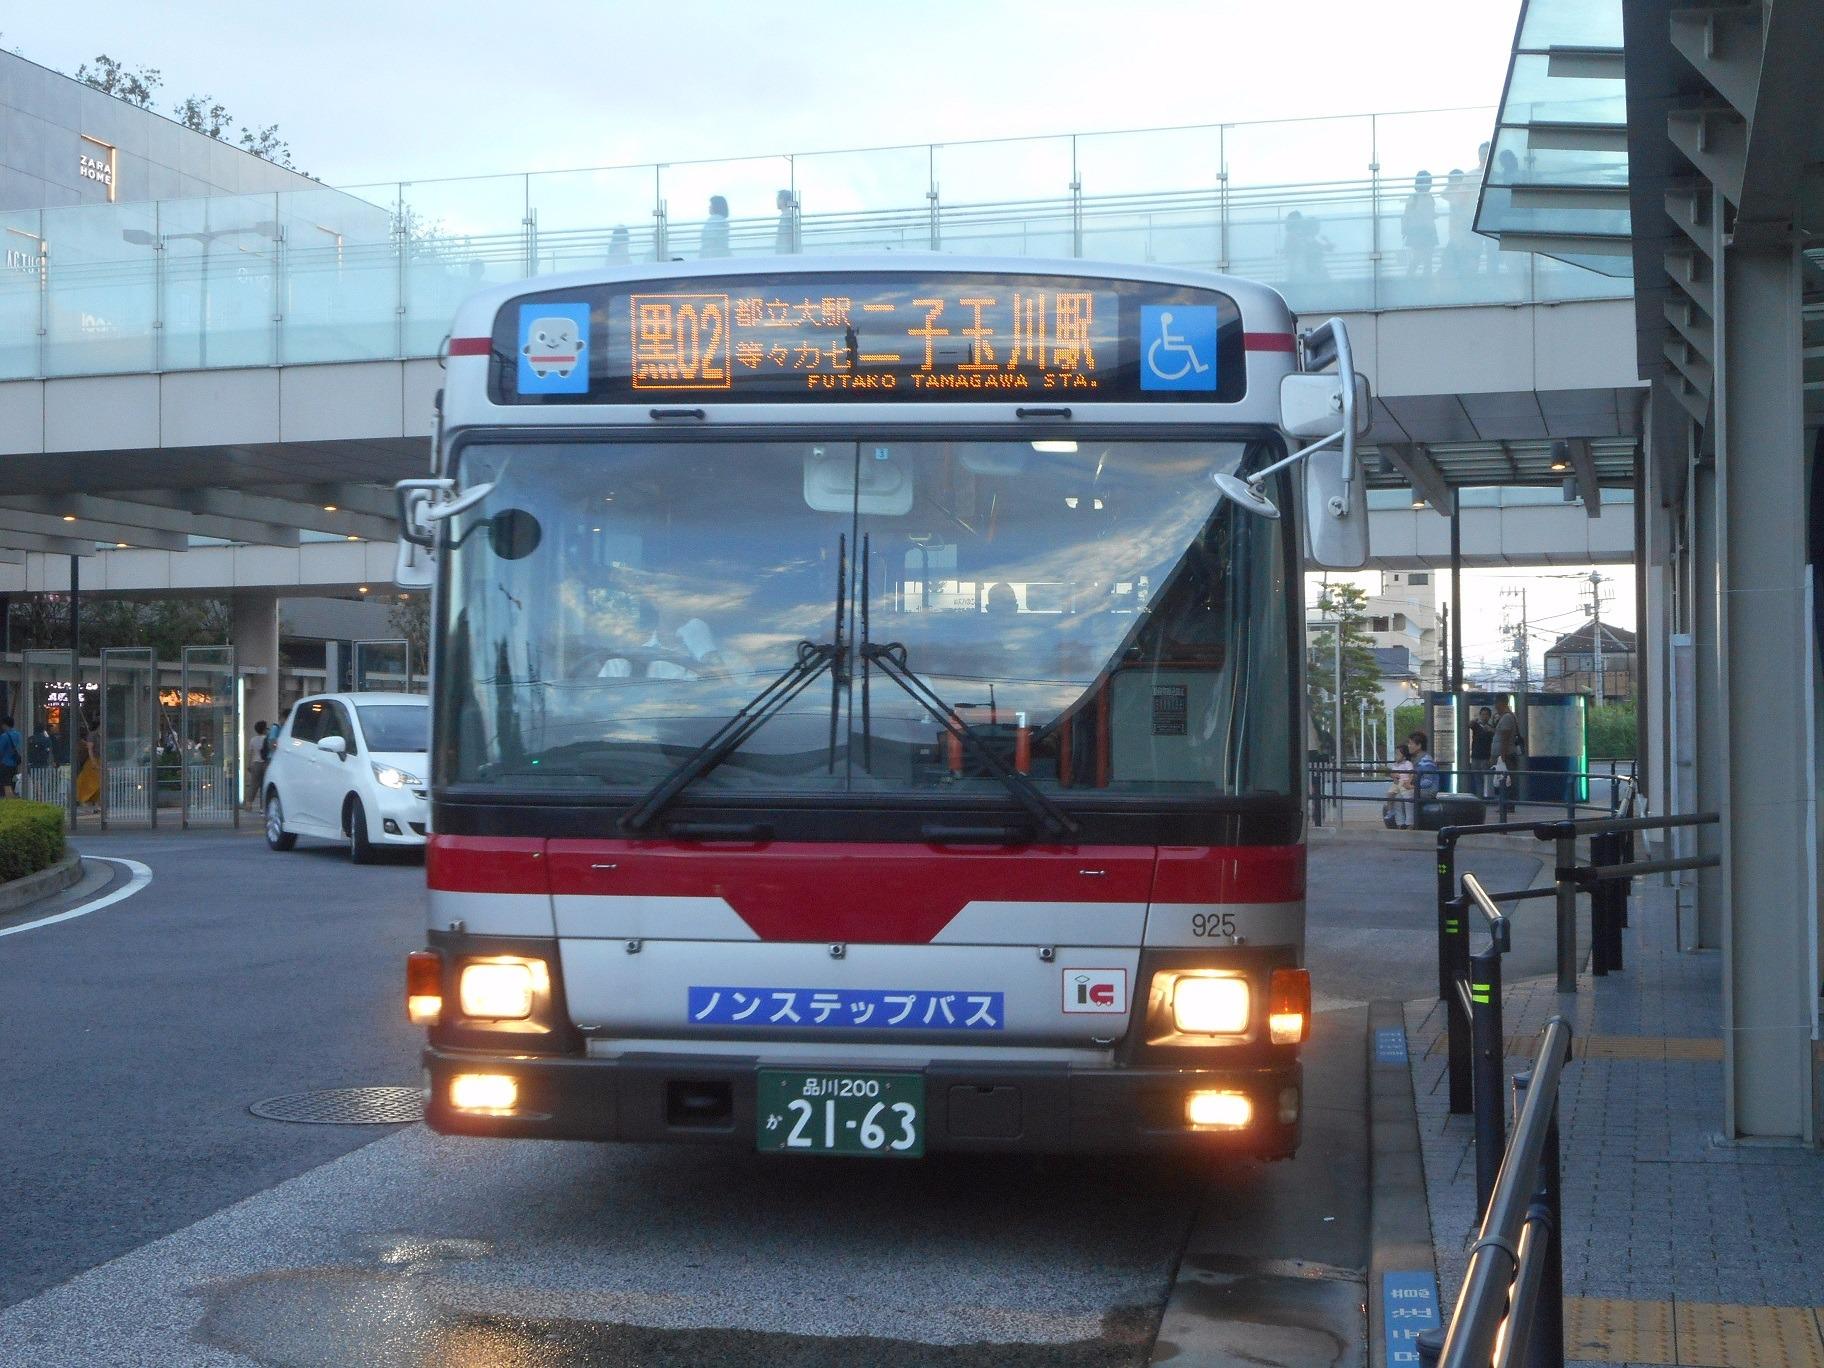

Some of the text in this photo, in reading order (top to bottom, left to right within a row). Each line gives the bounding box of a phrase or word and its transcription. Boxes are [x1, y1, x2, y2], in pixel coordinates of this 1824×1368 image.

[80, 154, 111, 174] ZARA
[80, 165, 111, 185] HOME
[734, 297, 851, 327] 都立大駅
[638, 304, 724, 379] 黒02
[859, 293, 1096, 371] 二子玉川駅
[808, 373, 1099, 389] FUTAKO TAMAGAWA STA.
[1192, 913, 1236, 938] 925
[695, 991, 997, 1028] ノンステップバス
[786, 1099, 917, 1151] 21-63
